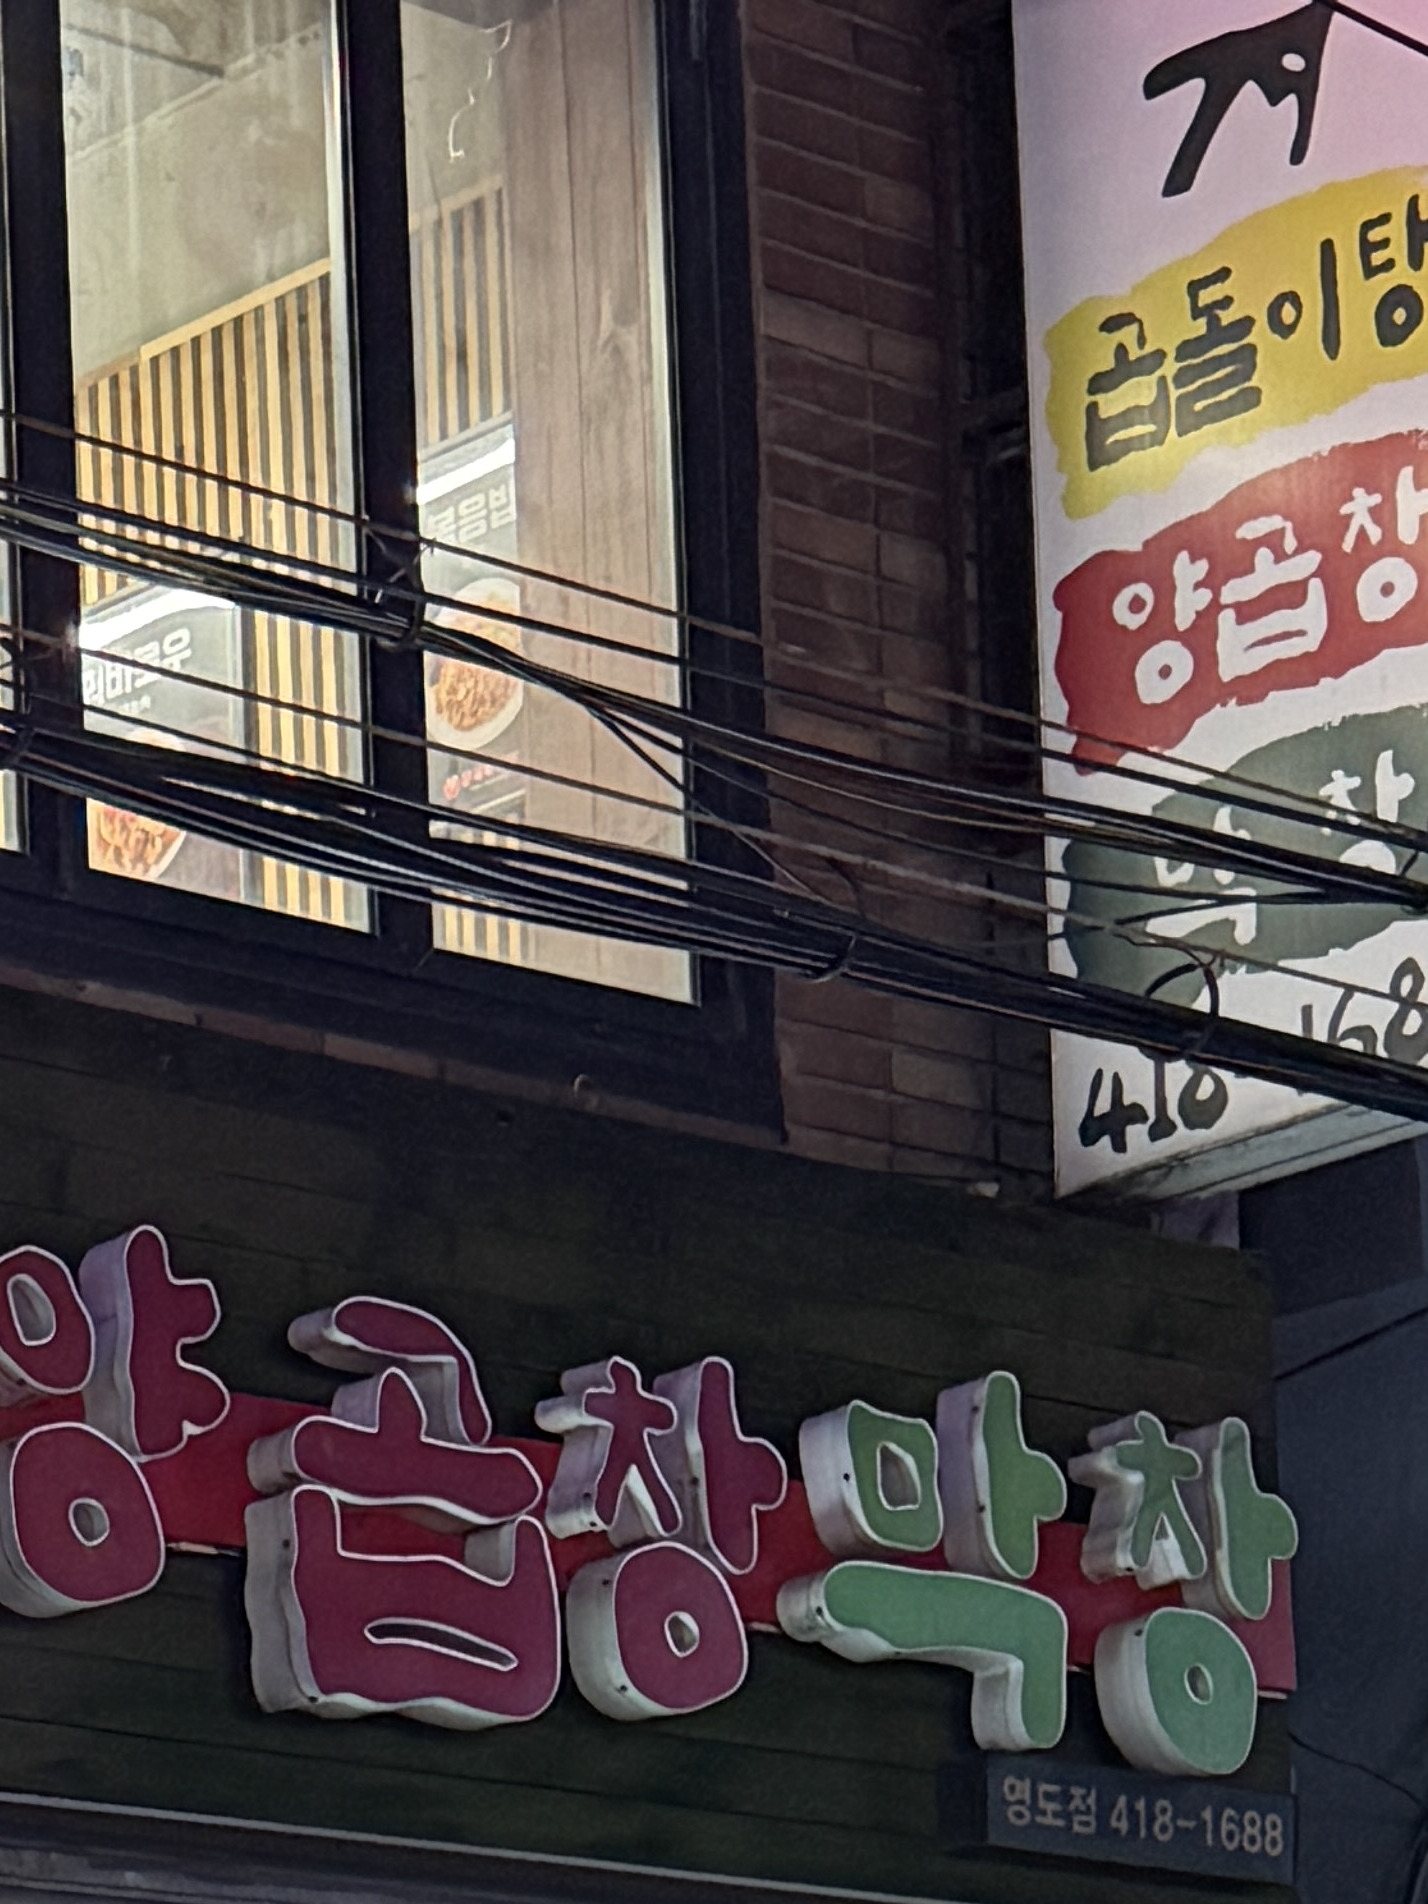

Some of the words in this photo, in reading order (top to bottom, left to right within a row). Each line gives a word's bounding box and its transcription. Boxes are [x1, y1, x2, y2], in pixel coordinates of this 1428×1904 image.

[1085, 195, 1428, 472] 곱돌이탕
[1112, 466, 1428, 704] 양곱창
[778, 1370, 1298, 1776] 막창
[1003, 1775, 1097, 1836] 영도점
[1110, 1794, 1284, 1857] 418-1688
